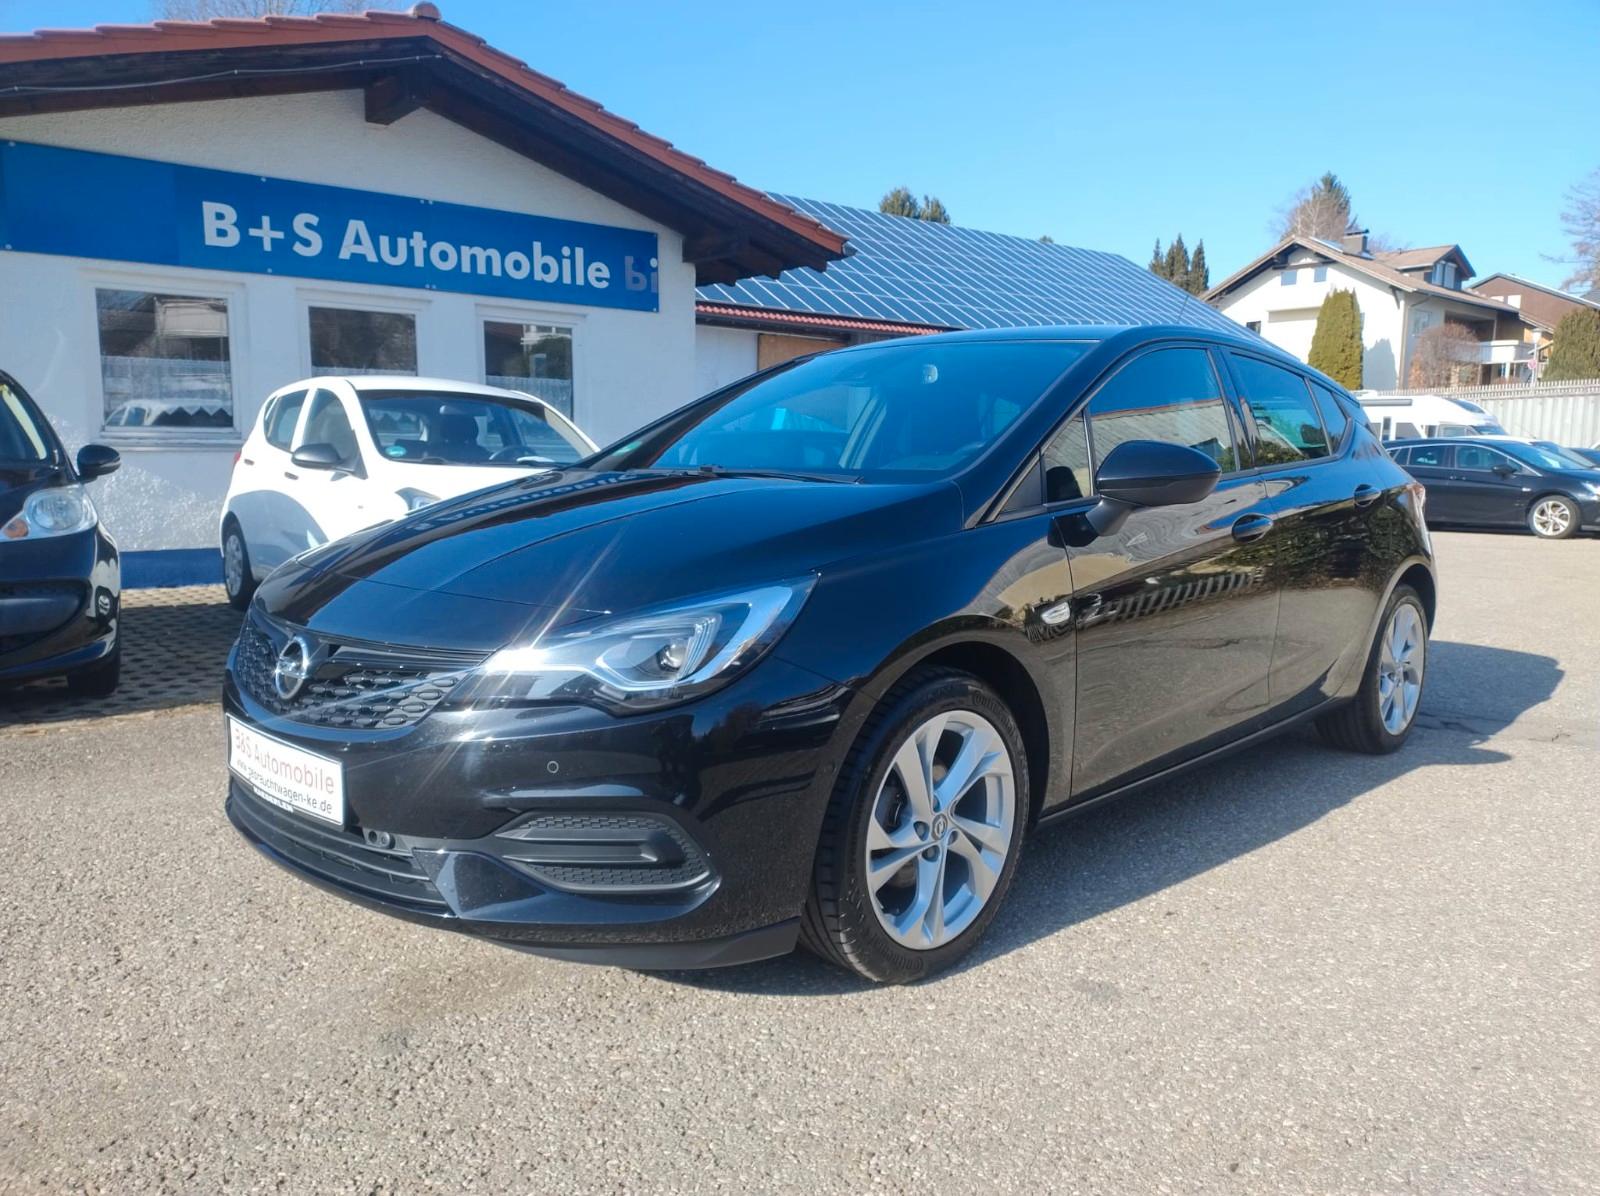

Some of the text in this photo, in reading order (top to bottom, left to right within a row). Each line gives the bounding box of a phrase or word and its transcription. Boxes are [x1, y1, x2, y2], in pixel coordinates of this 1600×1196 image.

[202, 201, 323, 257] B+S
[338, 219, 611, 289] Automobile
[254, 743, 335, 794] Automobile
